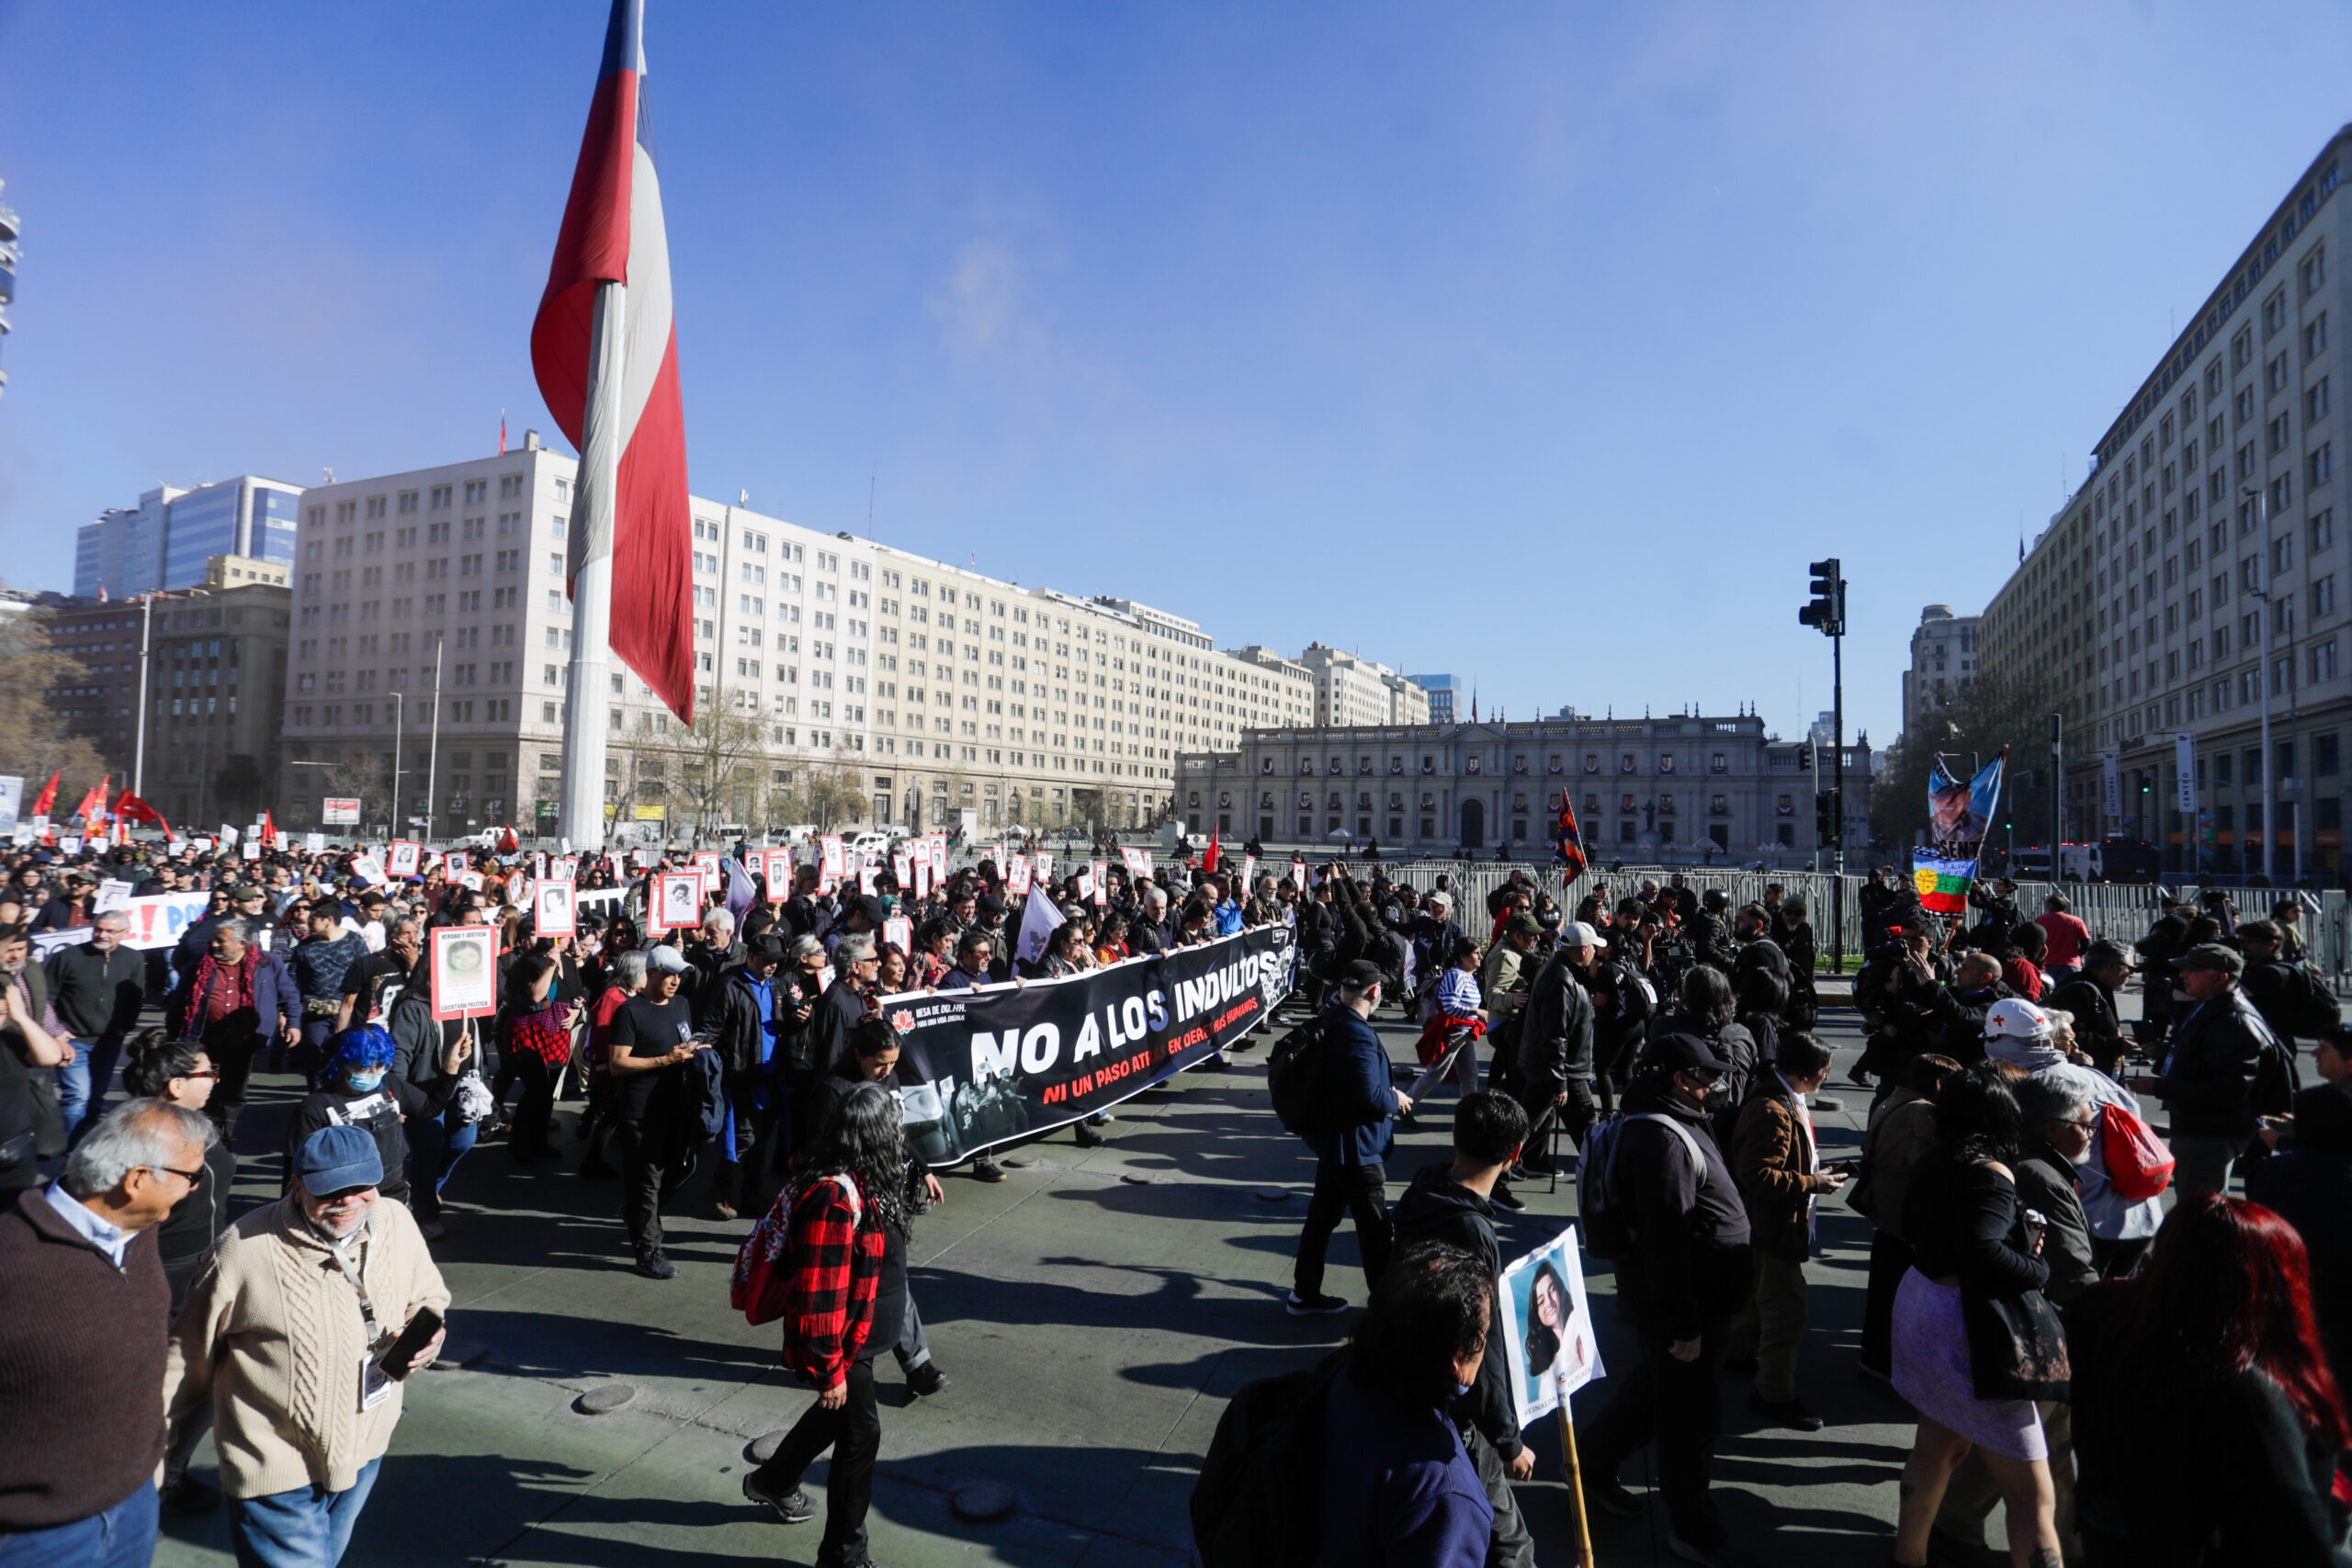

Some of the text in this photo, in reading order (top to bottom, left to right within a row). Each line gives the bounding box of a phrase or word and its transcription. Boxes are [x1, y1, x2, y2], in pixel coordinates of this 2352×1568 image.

[2182, 773, 2191, 807] CENTRO
[916, 1007, 931, 1018] MESA
[932, 1005, 940, 1015] DE
[917, 1014, 965, 1028] PARA UNA VIDA DIGNA
[971, 1022, 1059, 1085] NO
[1073, 1012, 1101, 1063] A
[1107, 989, 1169, 1049] LOS
[1174, 951, 1277, 1023] INDULTOS
[1044, 1083, 1067, 1104] NI
[1072, 1075, 1093, 1098] UN
[1096, 1060, 1130, 1088] PASO
[1168, 1036, 1182, 1055] EN
[1227, 997, 1259, 1024] HUMANOS
